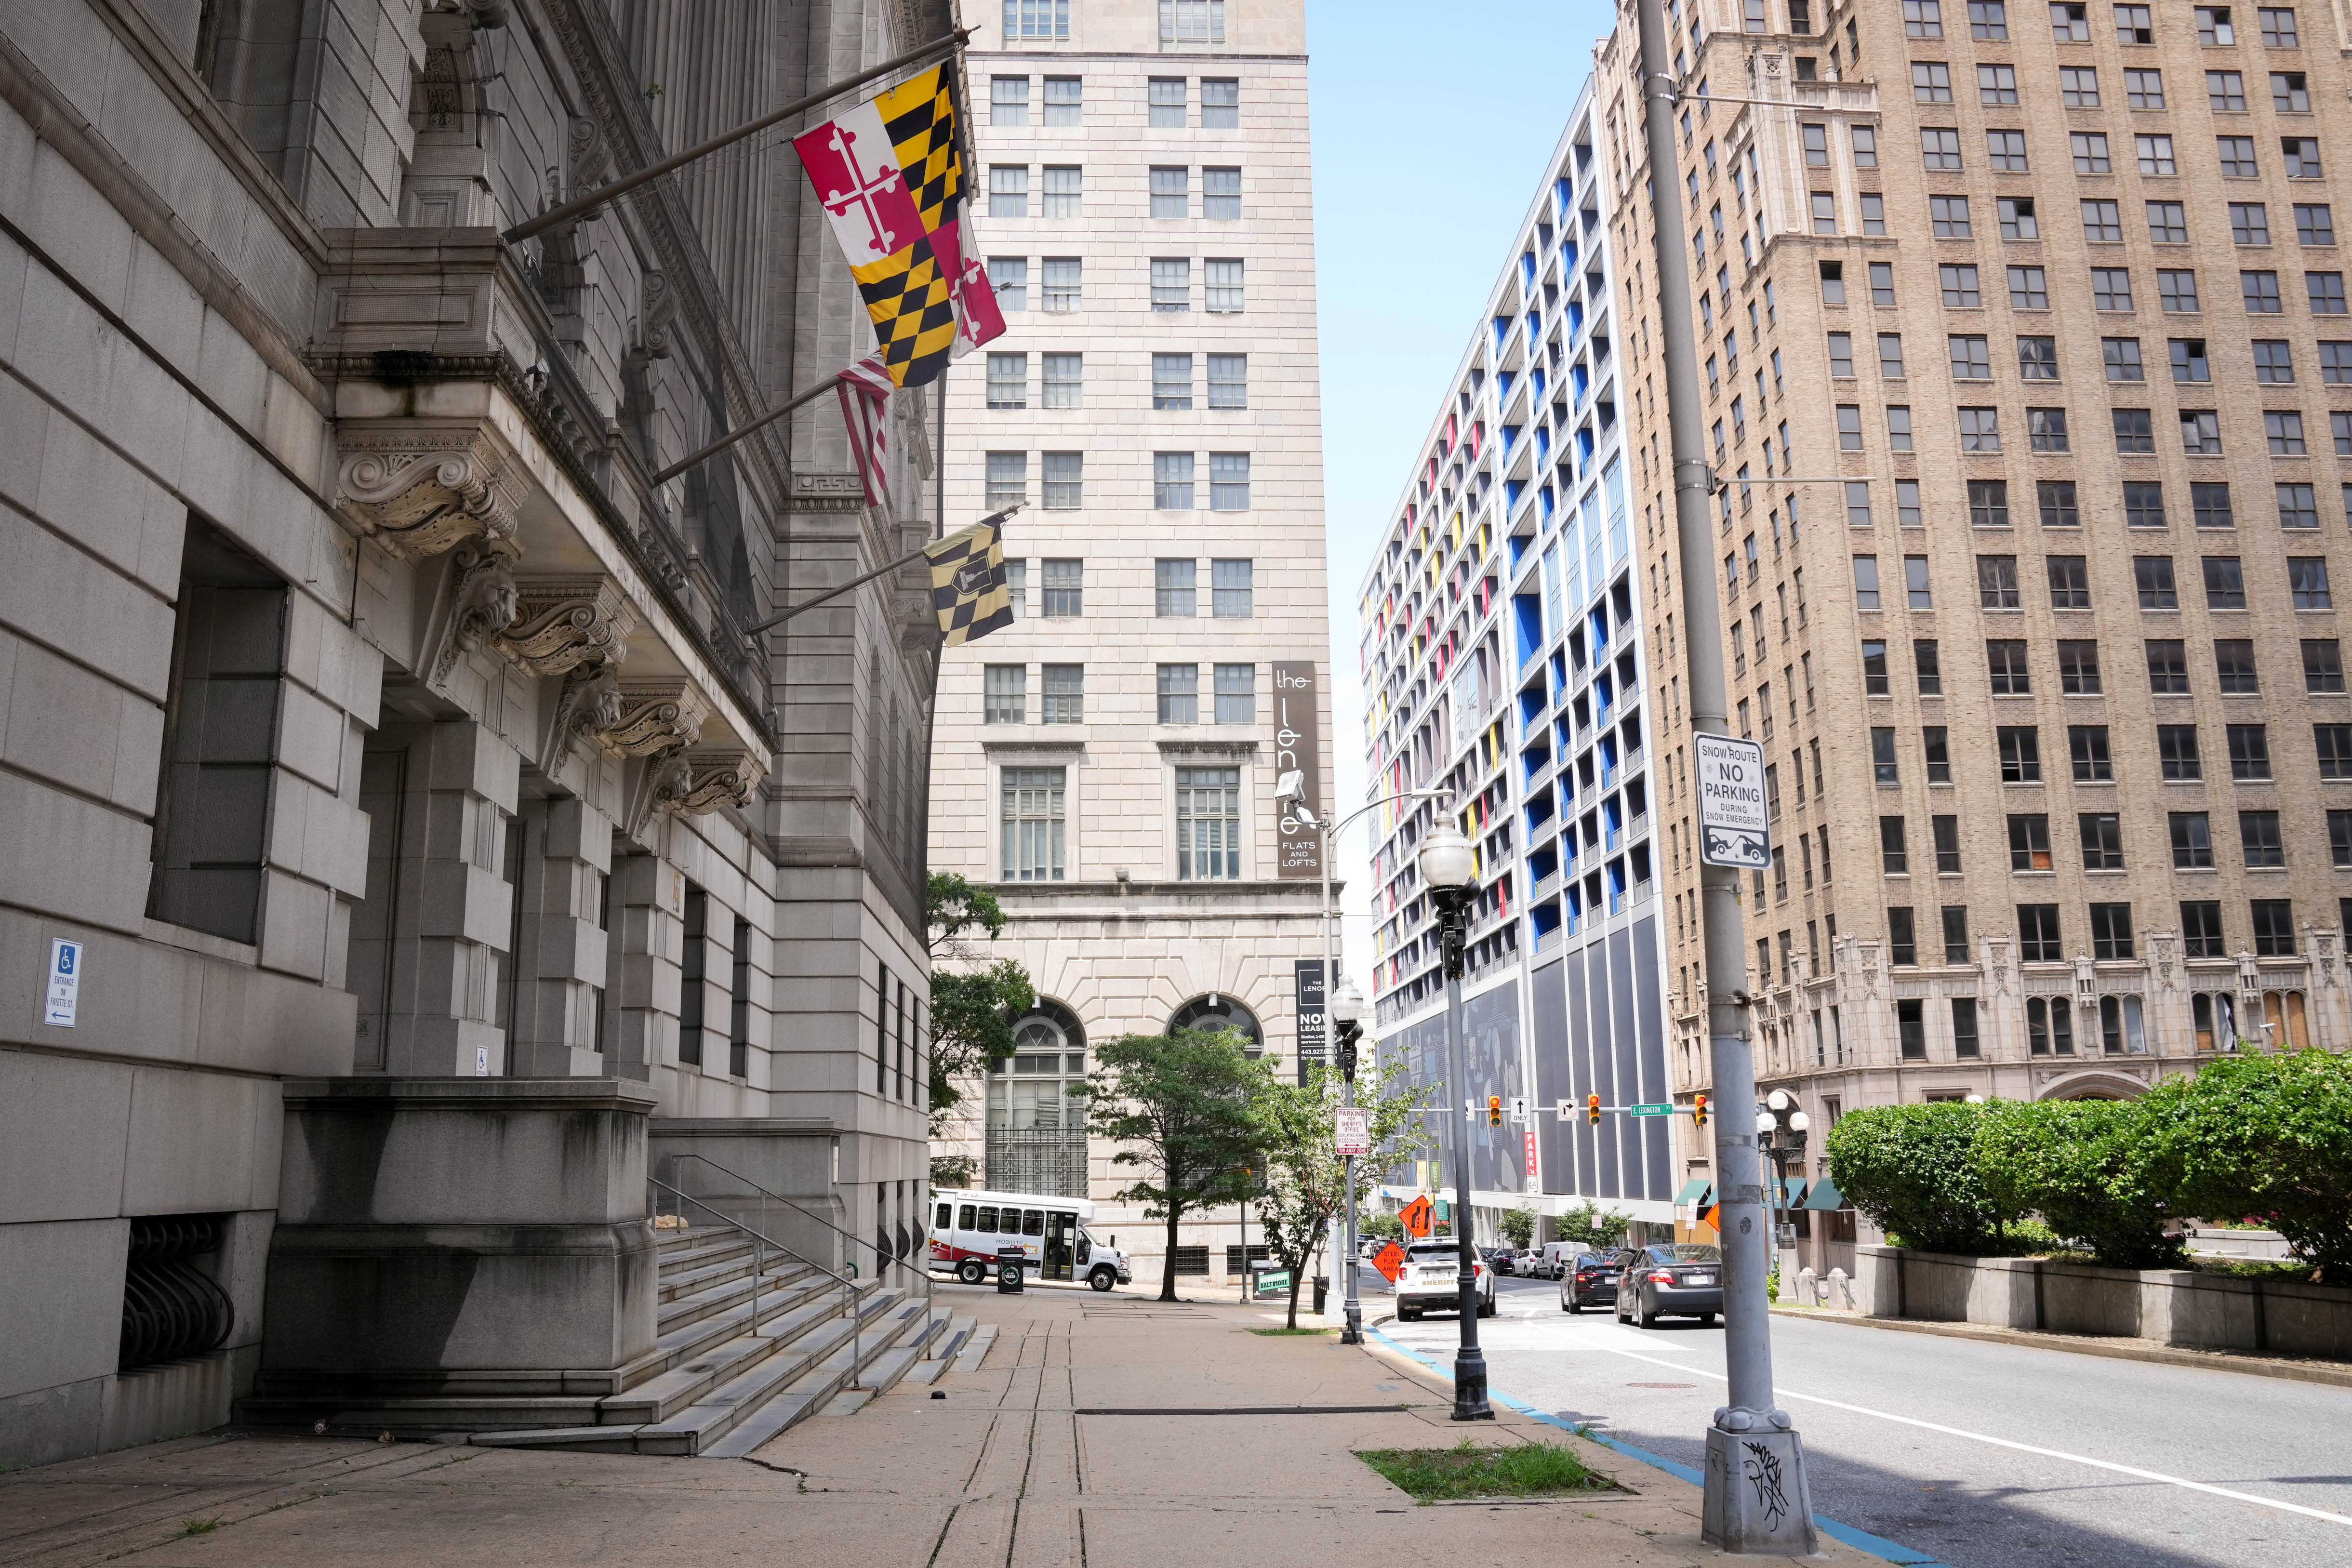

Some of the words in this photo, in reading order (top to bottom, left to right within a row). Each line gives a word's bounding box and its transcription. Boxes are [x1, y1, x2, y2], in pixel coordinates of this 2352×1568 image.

[1277, 670, 1312, 688] the
[1702, 745, 1727, 759] SNOW
[1729, 749, 1757, 763] ROUTE
[1277, 698, 1302, 835] lenre
[1719, 763, 1743, 782] NO
[1706, 783, 1759, 803] PARKING
[1721, 803, 1747, 814] DURING
[1706, 812, 1724, 822] SNOW
[1727, 814, 1763, 825] EMERGENCY
[54, 976, 74, 987] ENTRANCE
[60, 988, 66, 997] ON
[51, 997, 66, 1007] FAYETTE
[1300, 1013, 1325, 1024] NO
[1260, 1274, 1288, 1283] DOWNTOWN
[1261, 1279, 1288, 1289] BALTIMORE
